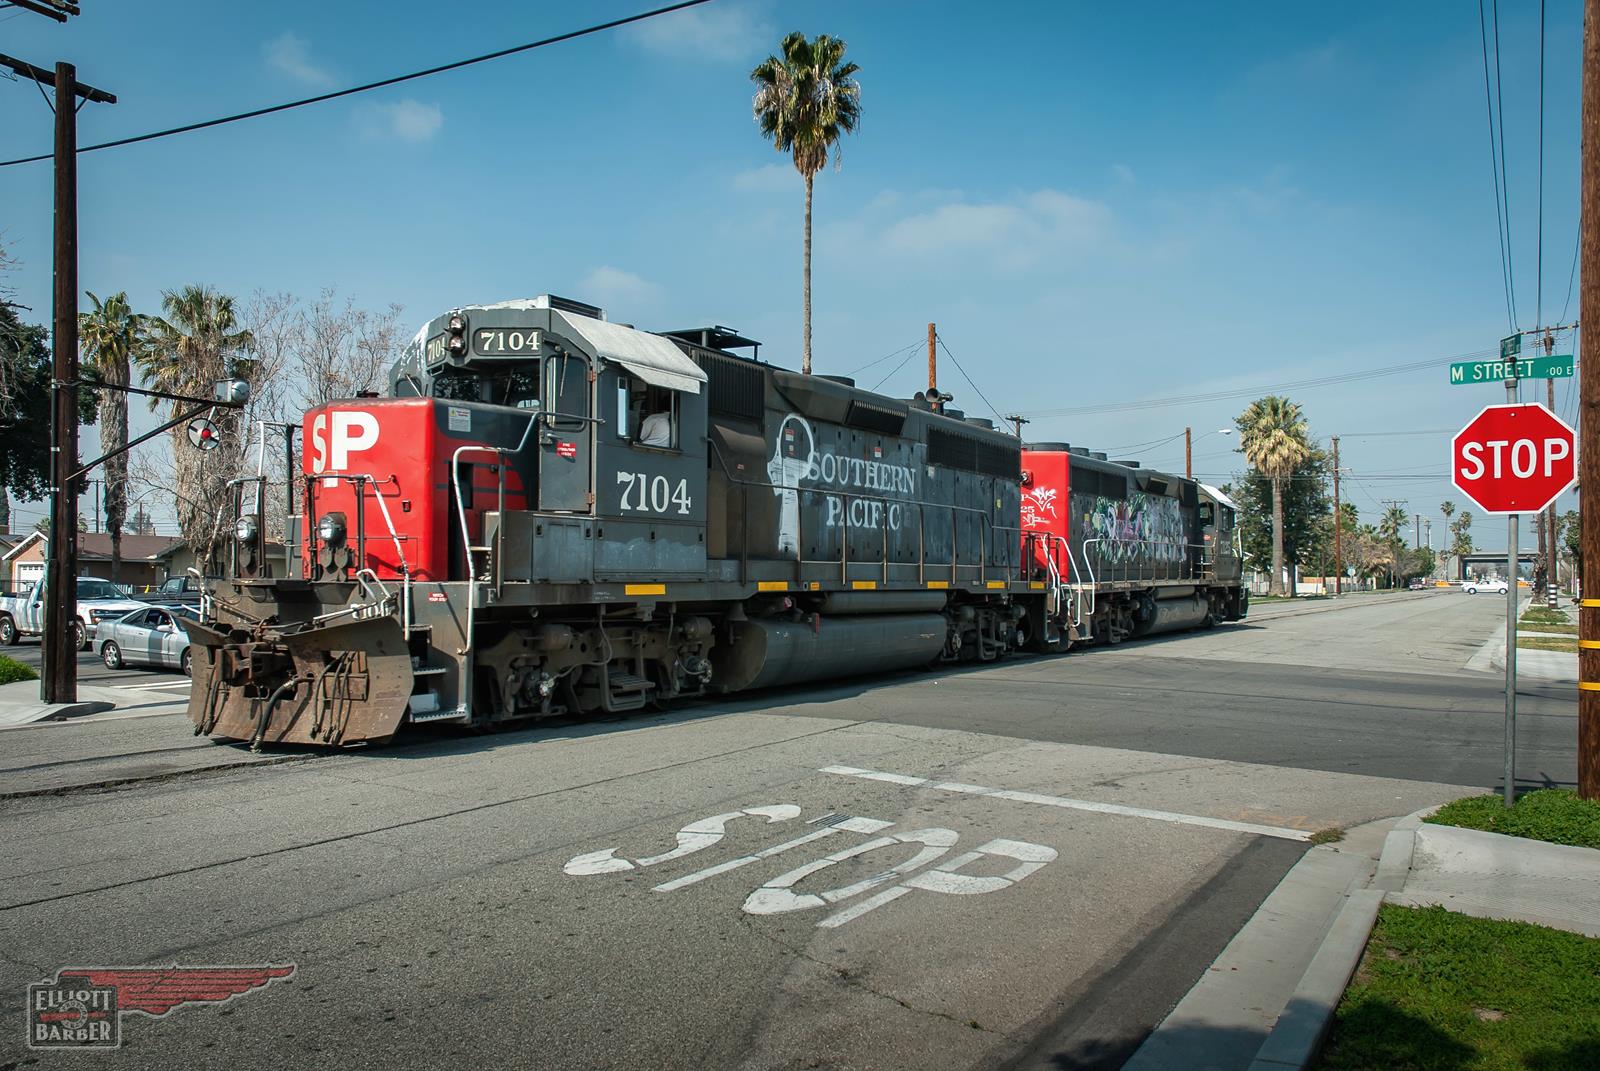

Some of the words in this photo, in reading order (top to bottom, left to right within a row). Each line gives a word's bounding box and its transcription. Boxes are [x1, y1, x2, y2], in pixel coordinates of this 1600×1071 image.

[480, 331, 540, 351] 7104
[1451, 366, 1464, 382] M
[1472, 361, 1534, 380] STREET
[1546, 366, 1562, 376] 00
[1566, 366, 1573, 375] E
[312, 411, 380, 474] SP
[1460, 438, 1570, 480] STOP
[617, 471, 691, 514] 7104
[806, 451, 916, 494] SOUTHERN
[826, 496, 901, 530] PACIFC
[486, 588, 497, 604] F
[562, 804, 1060, 928] STOP
